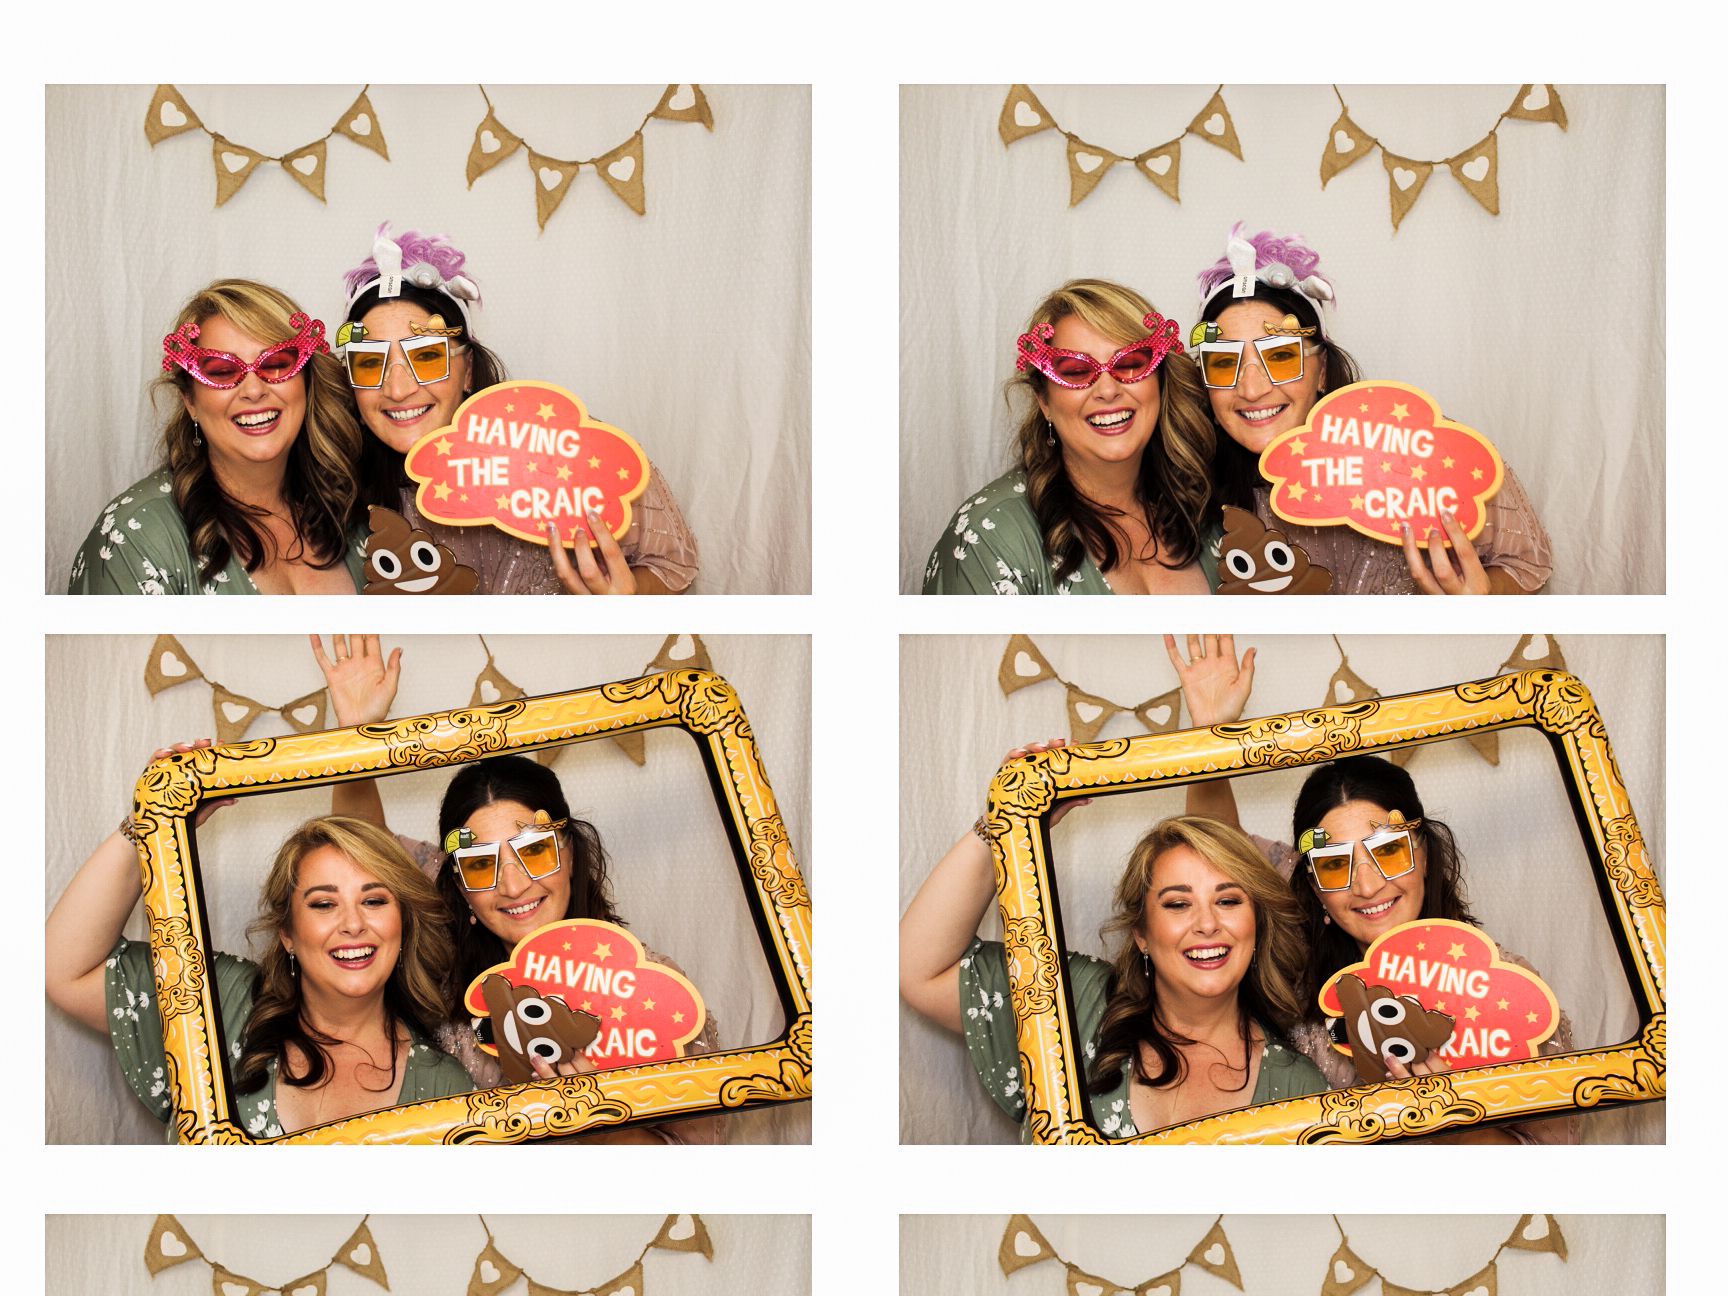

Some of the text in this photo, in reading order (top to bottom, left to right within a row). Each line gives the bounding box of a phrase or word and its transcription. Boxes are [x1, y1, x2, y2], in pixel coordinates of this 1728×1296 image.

[466, 413, 581, 458] HAVING
[1320, 413, 1435, 458] HAVING
[447, 456, 510, 487] THE
[1301, 456, 1364, 487] THE
[509, 486, 605, 519] CRAIC
[1363, 486, 1459, 519] CRAIC
[523, 951, 636, 998] HAVING
[1377, 951, 1490, 998] HAVING
[584, 1027, 658, 1059] RAIC
[1438, 1027, 1512, 1059] RAIC
